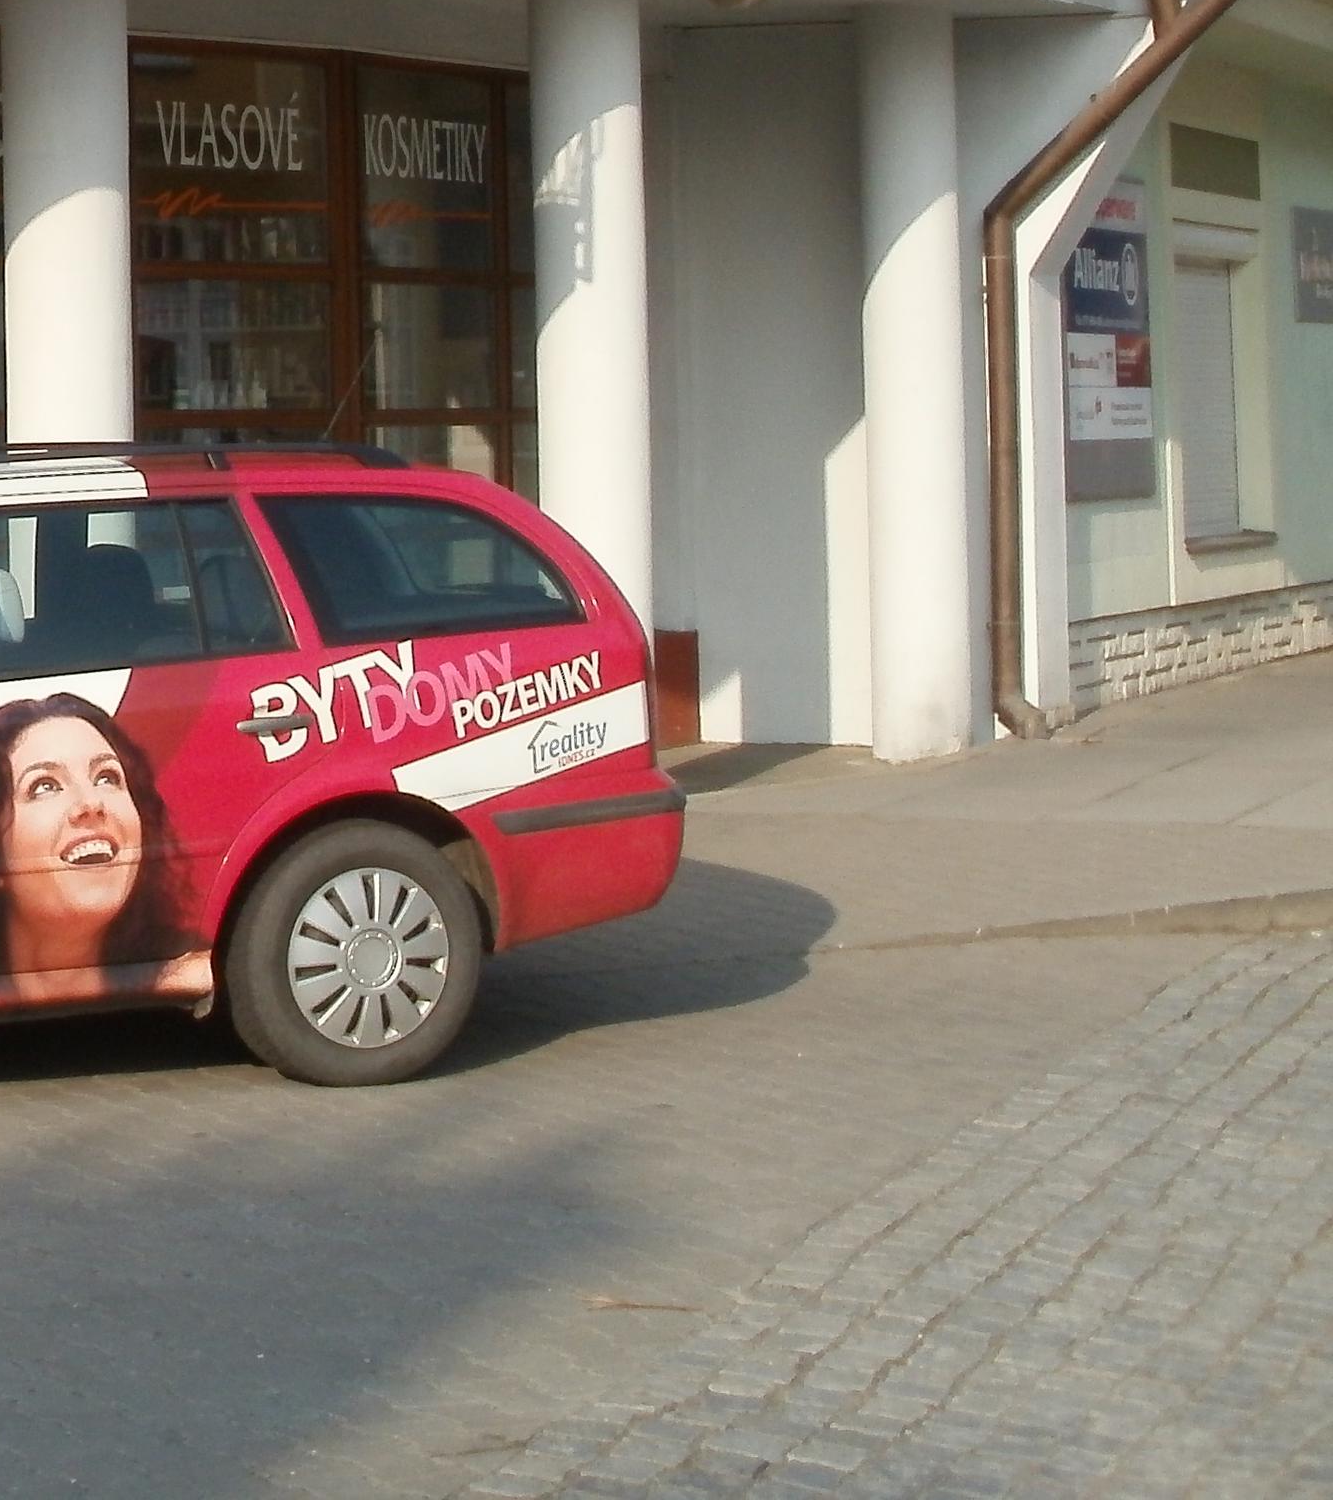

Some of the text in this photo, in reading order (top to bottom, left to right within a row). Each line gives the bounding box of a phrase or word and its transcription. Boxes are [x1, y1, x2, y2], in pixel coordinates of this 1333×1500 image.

[156, 92, 303, 171] VLASOVÉ
[362, 113, 488, 184] KOSMETIKY
[249, 639, 422, 763] BYTY
[366, 642, 514, 744] DOMY
[452, 650, 603, 740] POZEMKY
[540, 721, 607, 762] reality
